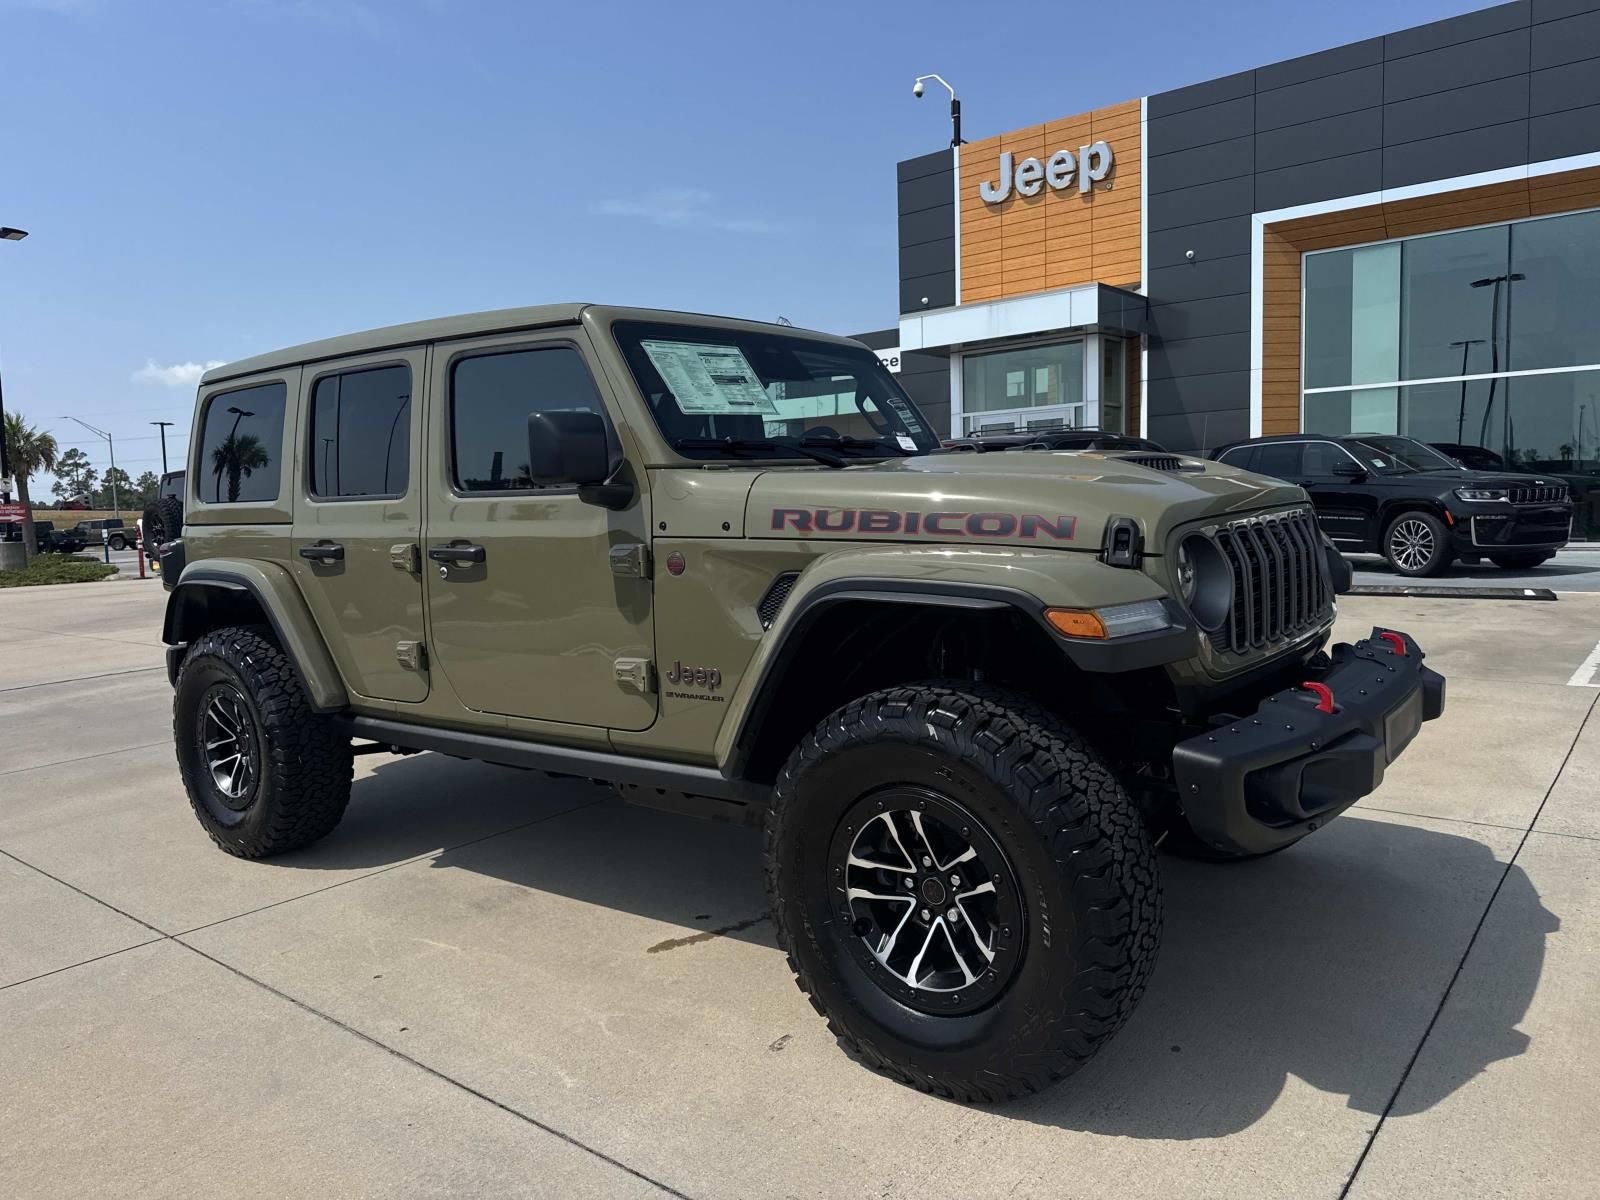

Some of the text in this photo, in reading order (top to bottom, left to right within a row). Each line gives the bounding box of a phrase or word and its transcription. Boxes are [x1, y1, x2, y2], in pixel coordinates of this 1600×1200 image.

[979, 140, 1113, 204] Jeep
[770, 508, 1077, 540] RUBICON
[665, 660, 722, 691] Jeep
[674, 692, 725, 702] WRANGLER
